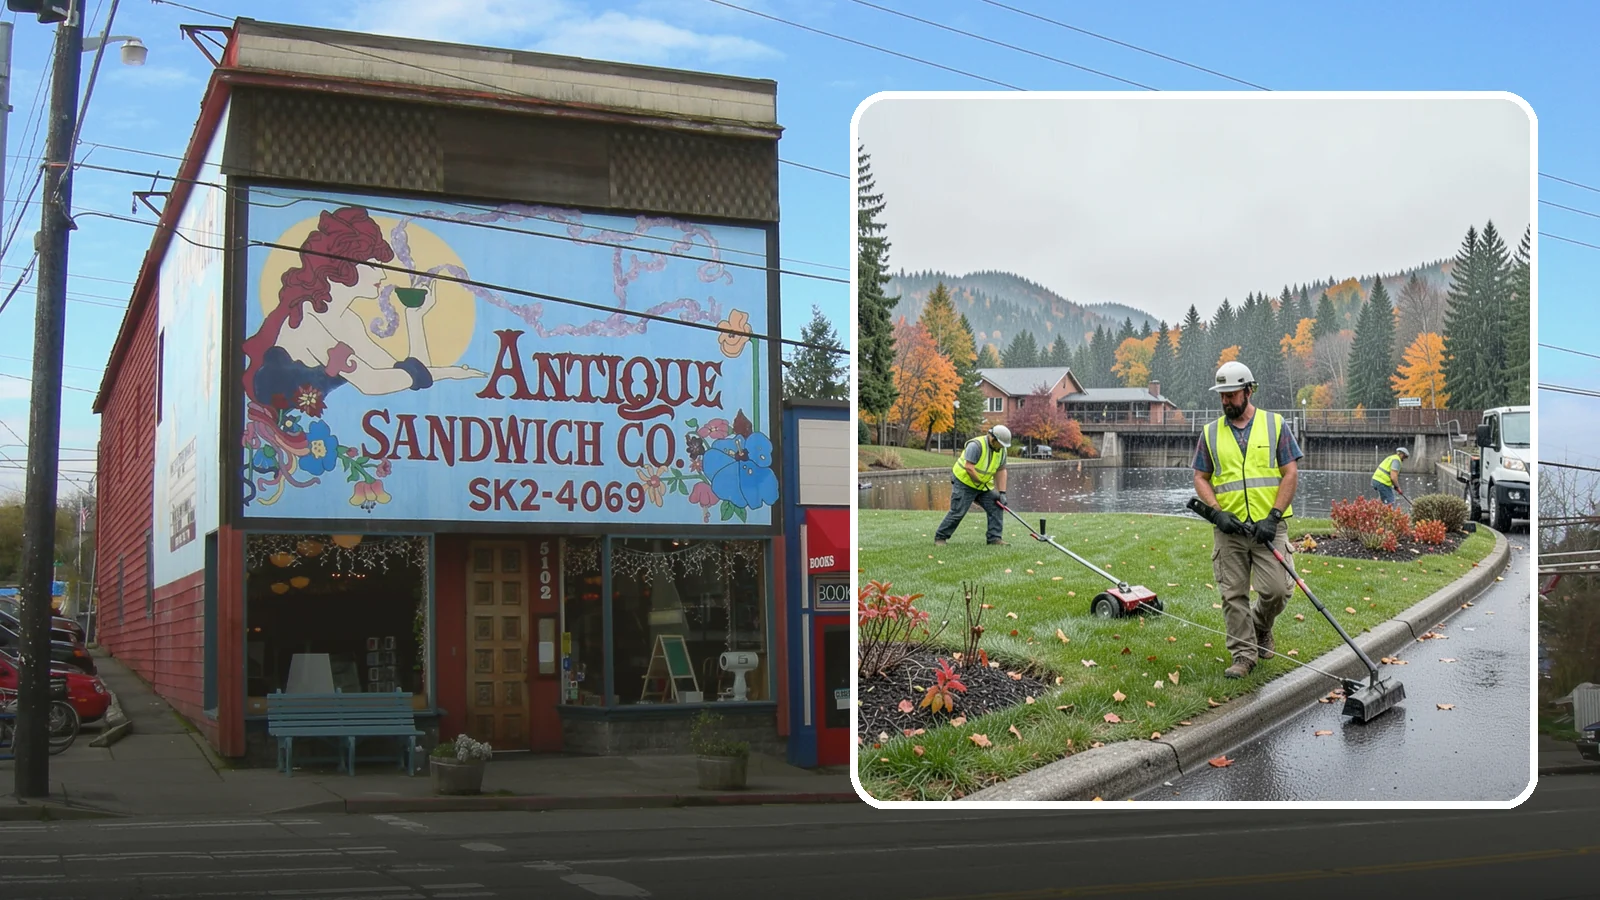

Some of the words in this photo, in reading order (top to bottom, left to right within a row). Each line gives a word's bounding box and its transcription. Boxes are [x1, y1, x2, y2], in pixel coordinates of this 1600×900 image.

[361, 408, 604, 467] SANDWICH
[617, 421, 685, 469] CO.
[469, 477, 646, 513] SK2-4069
[540, 541, 551, 600] 5102
[809, 554, 835, 569] BOOKS
